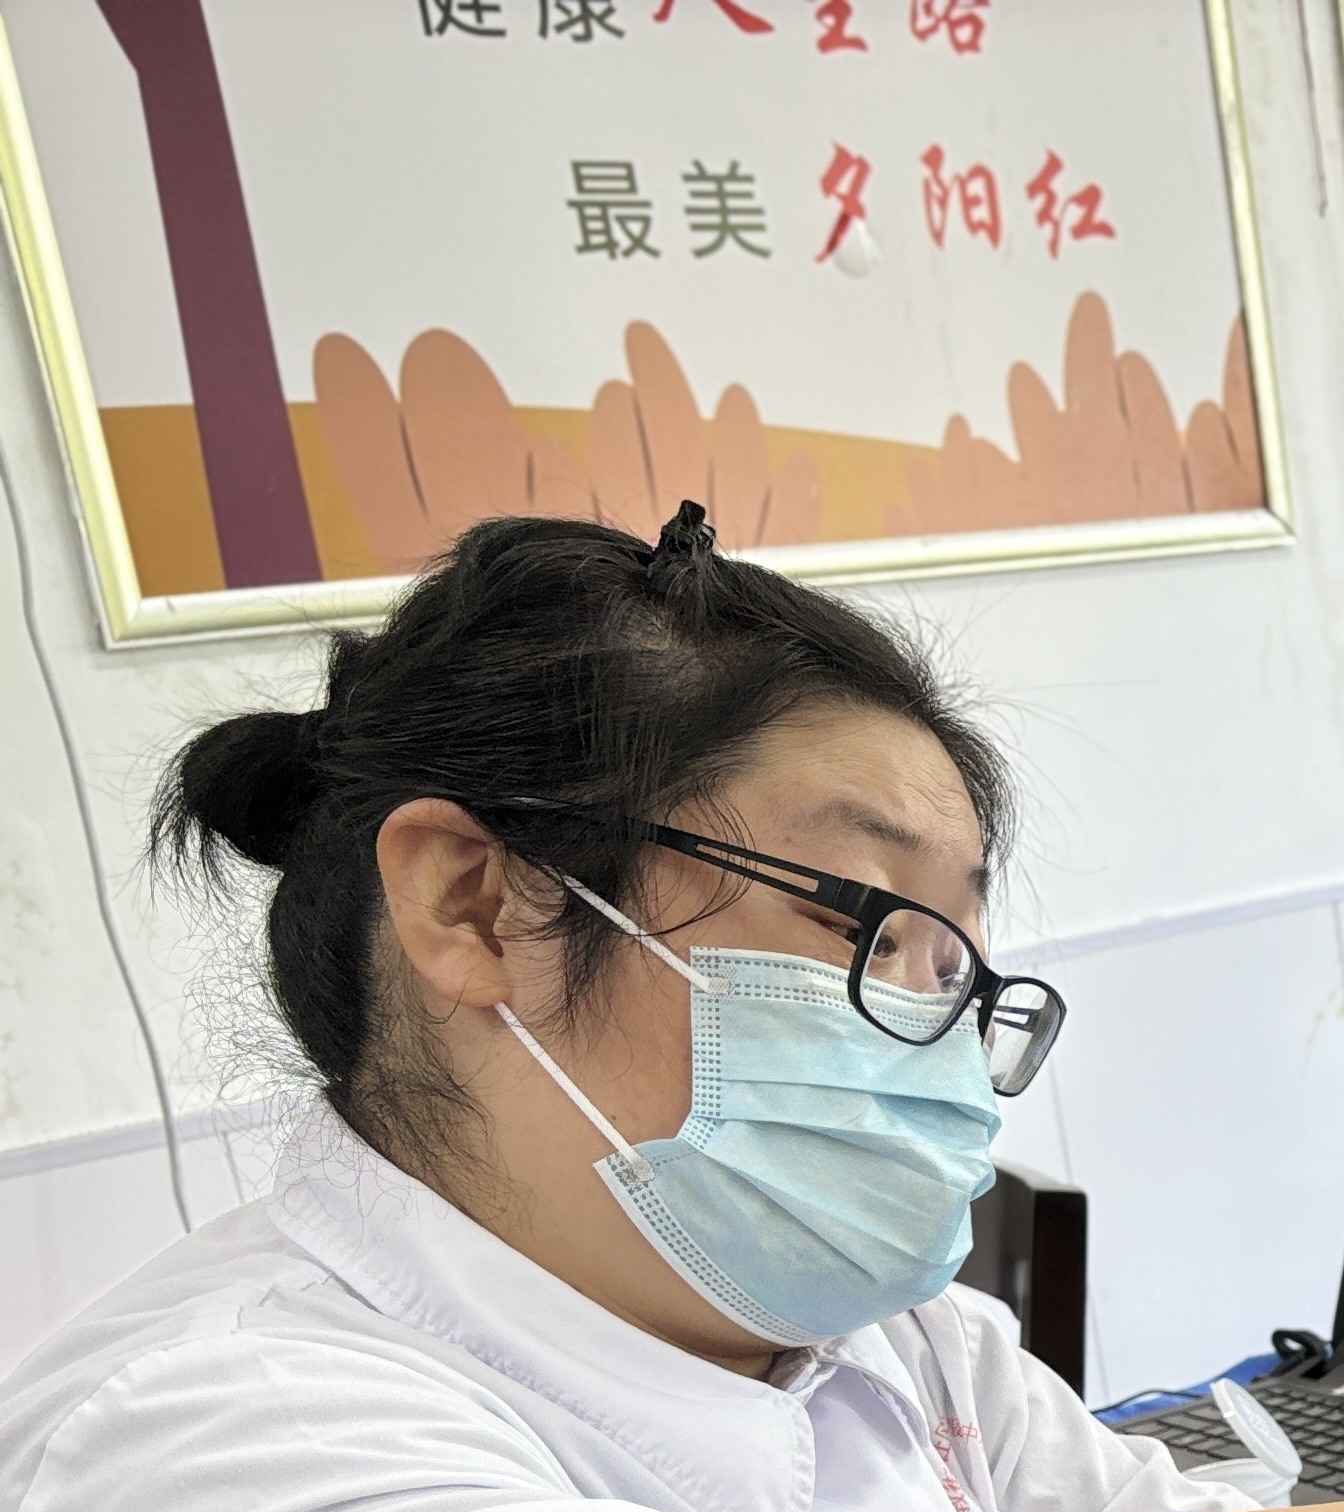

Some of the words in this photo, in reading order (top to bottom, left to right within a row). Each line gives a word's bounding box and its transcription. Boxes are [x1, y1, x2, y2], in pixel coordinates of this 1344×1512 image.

[565, 139, 1117, 263] 最美夕阳红
